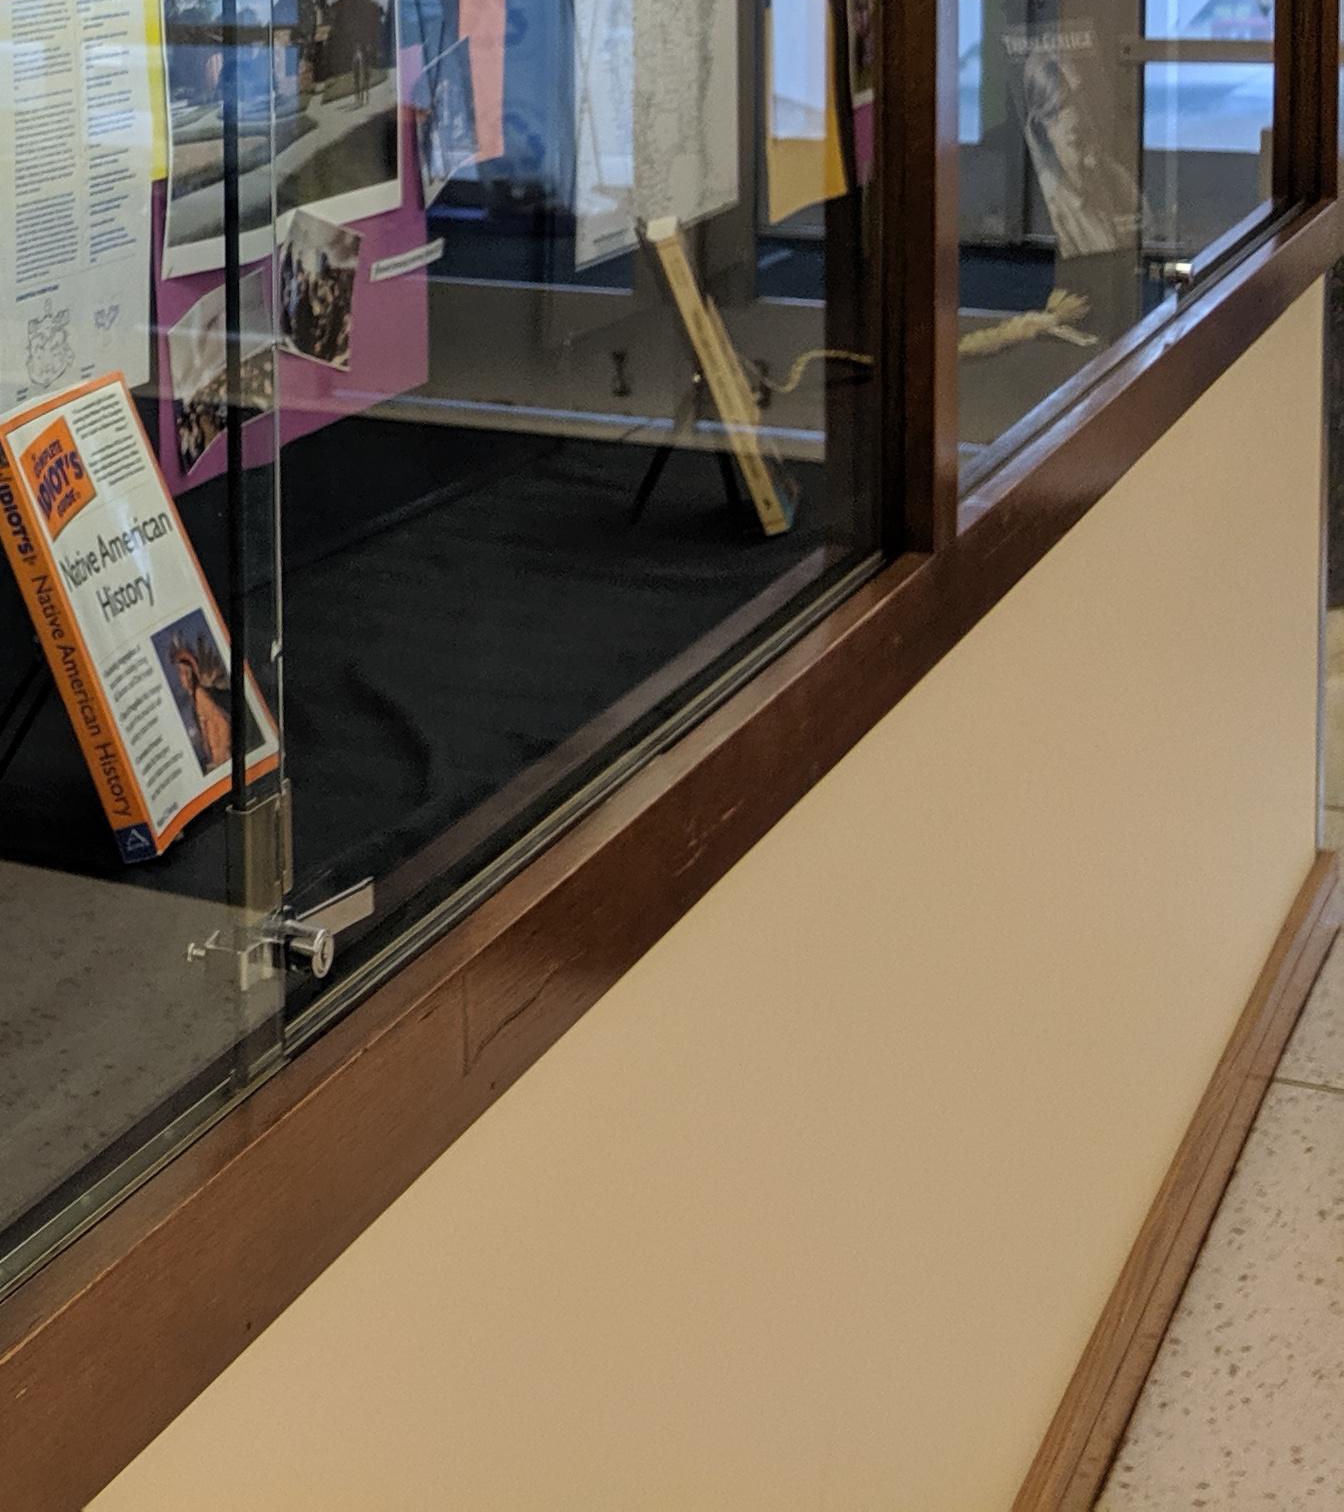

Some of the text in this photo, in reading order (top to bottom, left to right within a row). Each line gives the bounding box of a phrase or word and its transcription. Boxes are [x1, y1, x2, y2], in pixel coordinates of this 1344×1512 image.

[37, 451, 84, 520] IDIOT'S
[59, 512, 174, 592] Native American
[96, 573, 155, 623] History
[32, 575, 66, 641] Native
[56, 643, 102, 738] American
[94, 744, 132, 819] History
